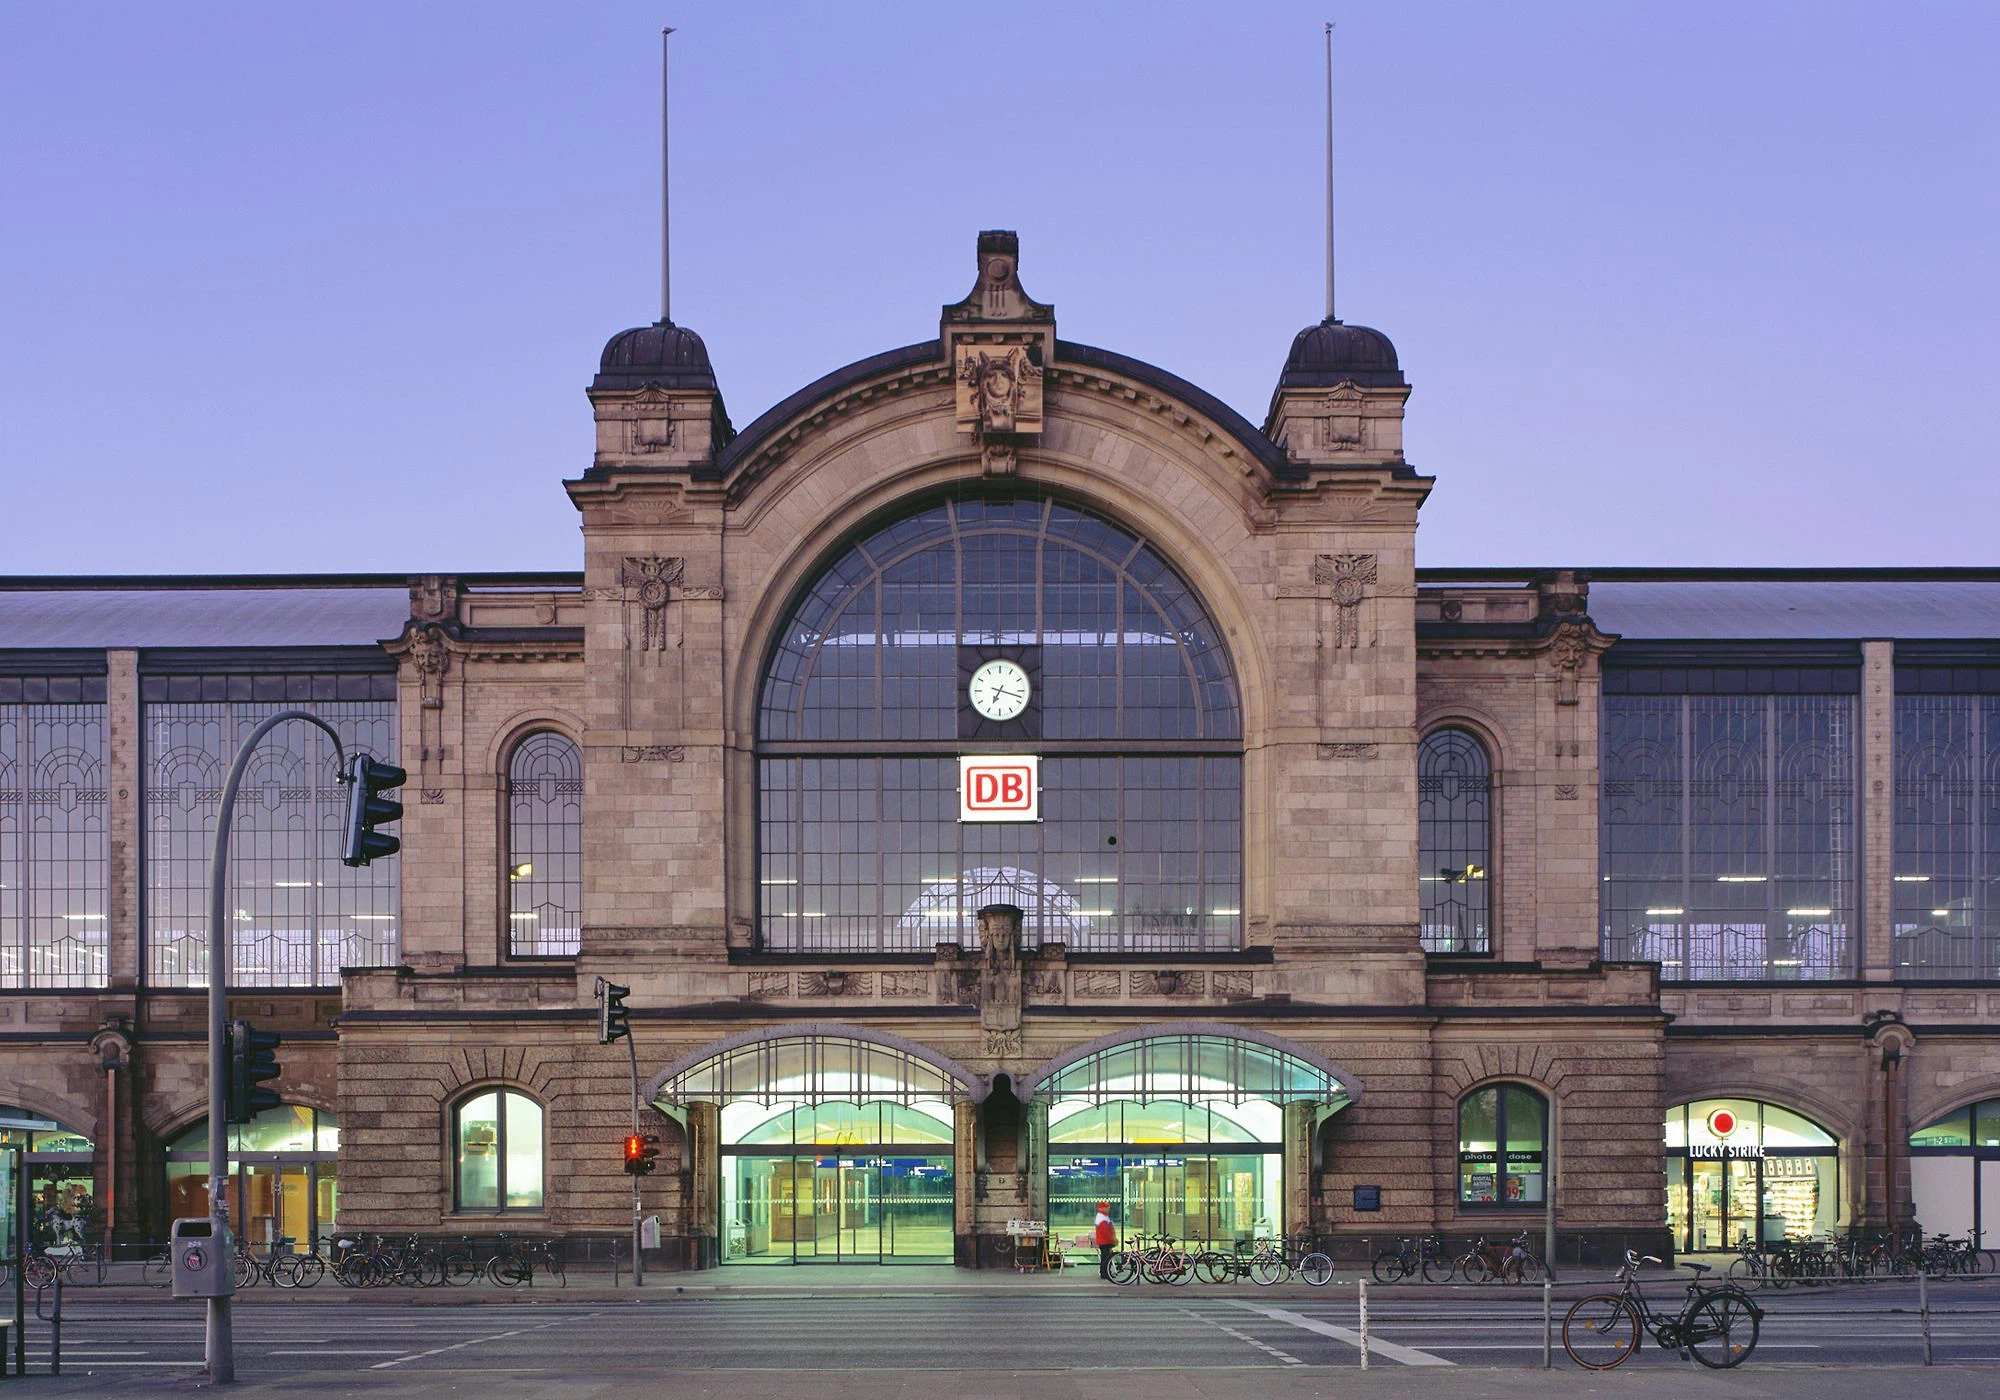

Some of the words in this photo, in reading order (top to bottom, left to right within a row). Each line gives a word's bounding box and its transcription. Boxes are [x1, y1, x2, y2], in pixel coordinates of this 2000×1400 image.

[976, 773, 1023, 802] DB
[1689, 1145, 1725, 1157] LUCKY
[1728, 1145, 1764, 1157] STRIKE
